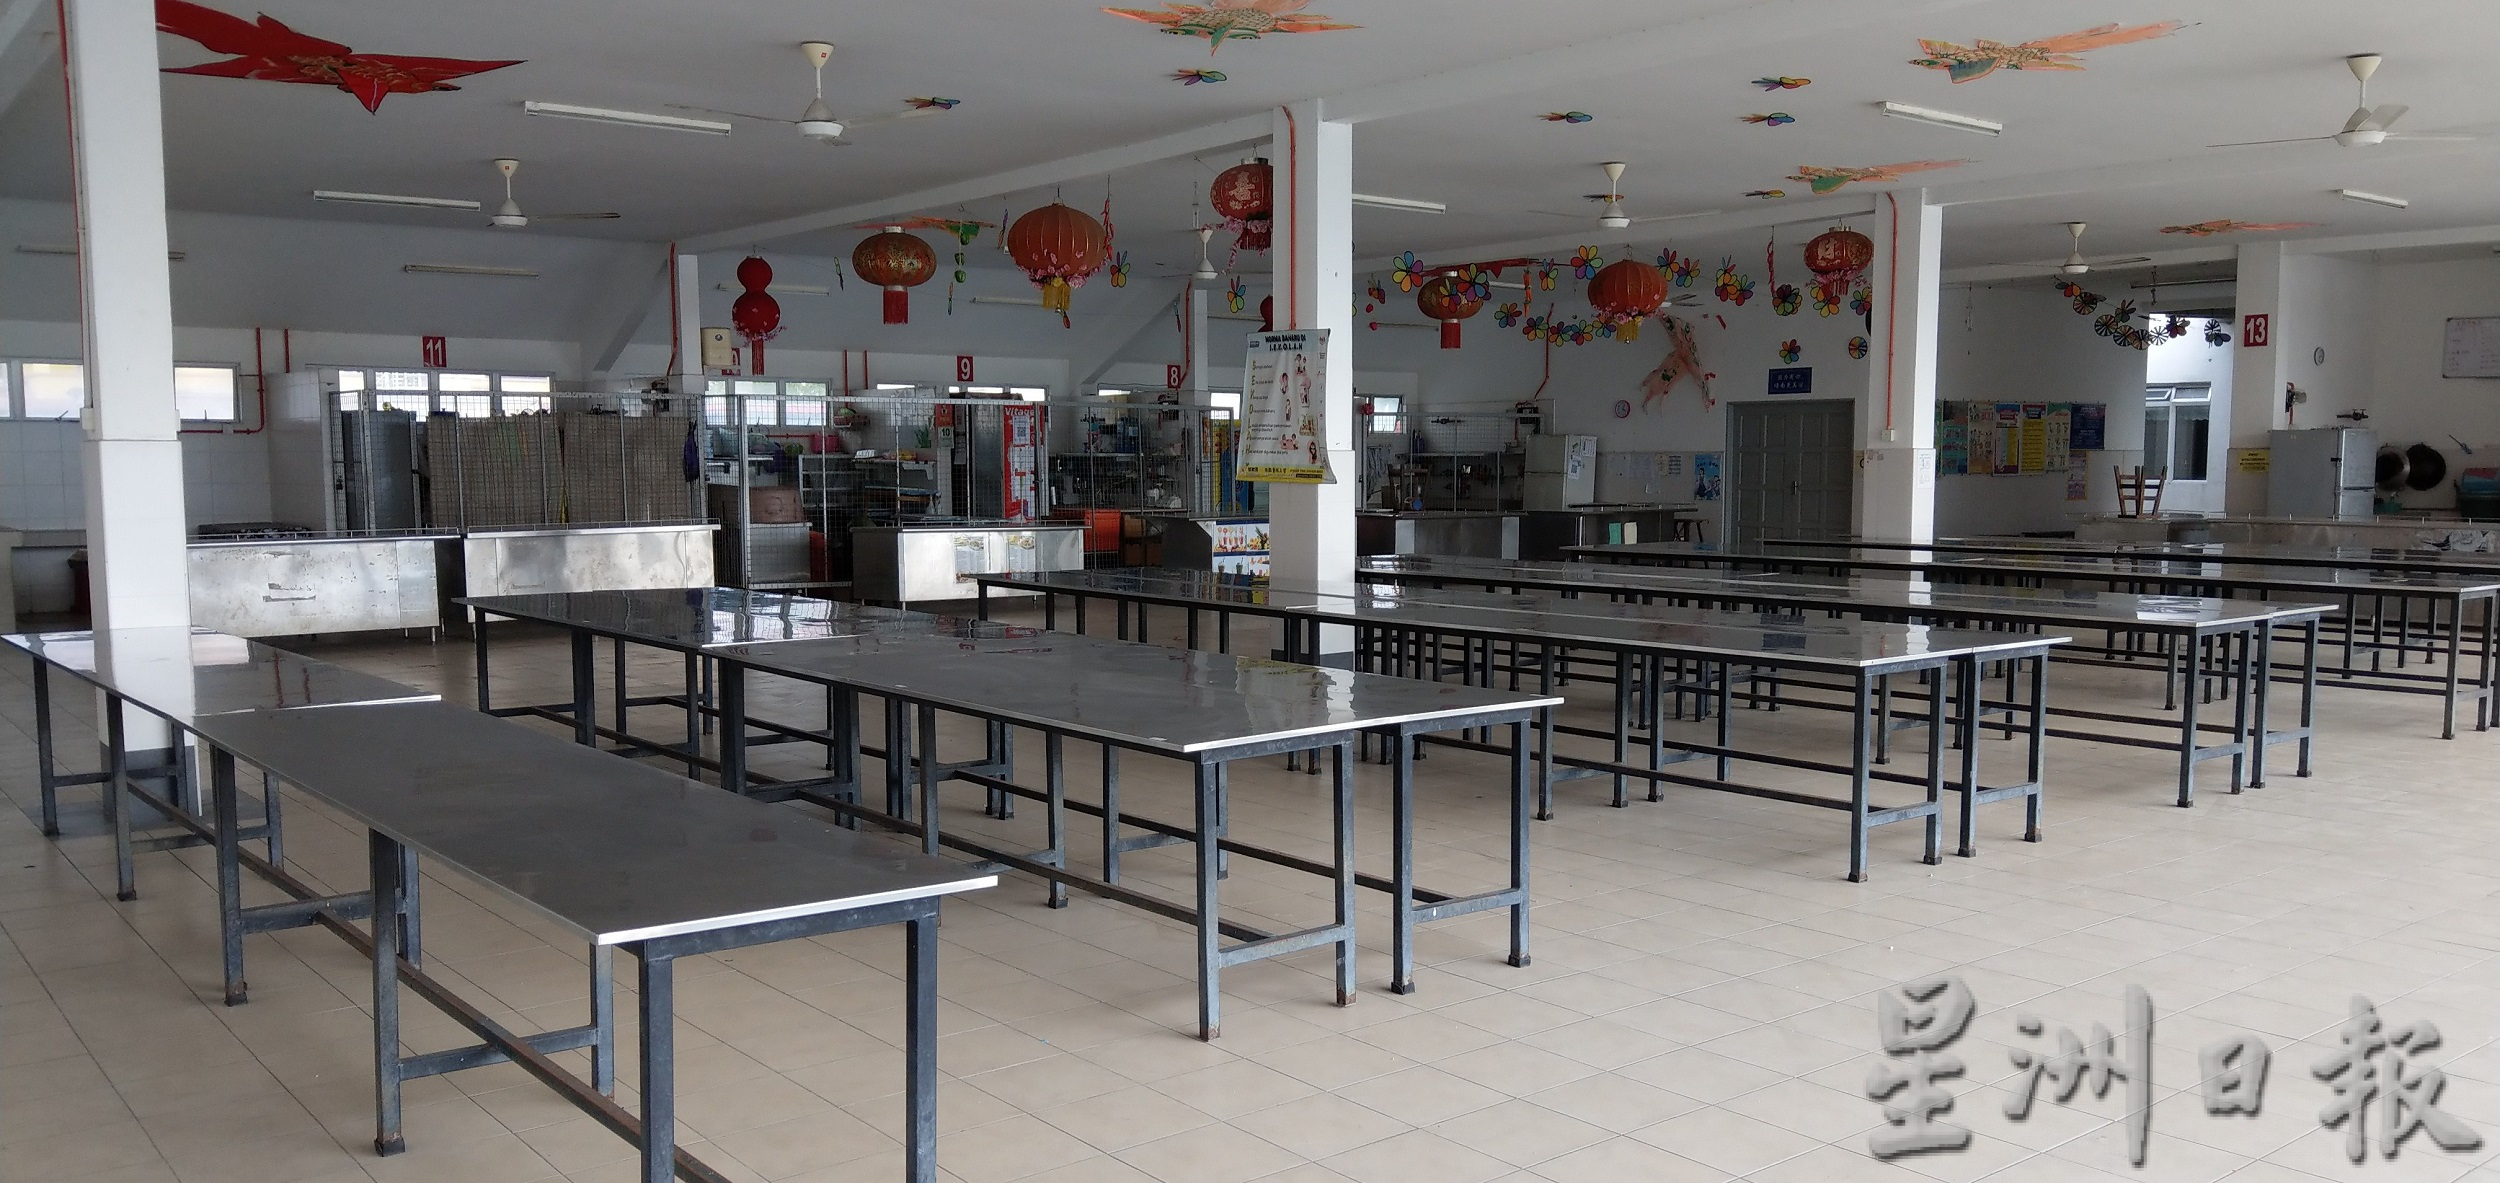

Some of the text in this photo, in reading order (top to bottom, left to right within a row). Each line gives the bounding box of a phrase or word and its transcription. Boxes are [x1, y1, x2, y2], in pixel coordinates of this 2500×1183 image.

[2246, 317, 2266, 344] 13
[426, 338, 443, 366] 11
[961, 358, 970, 380] 9
[1170, 366, 1178, 386] 8
[942, 428, 950, 436] 10
